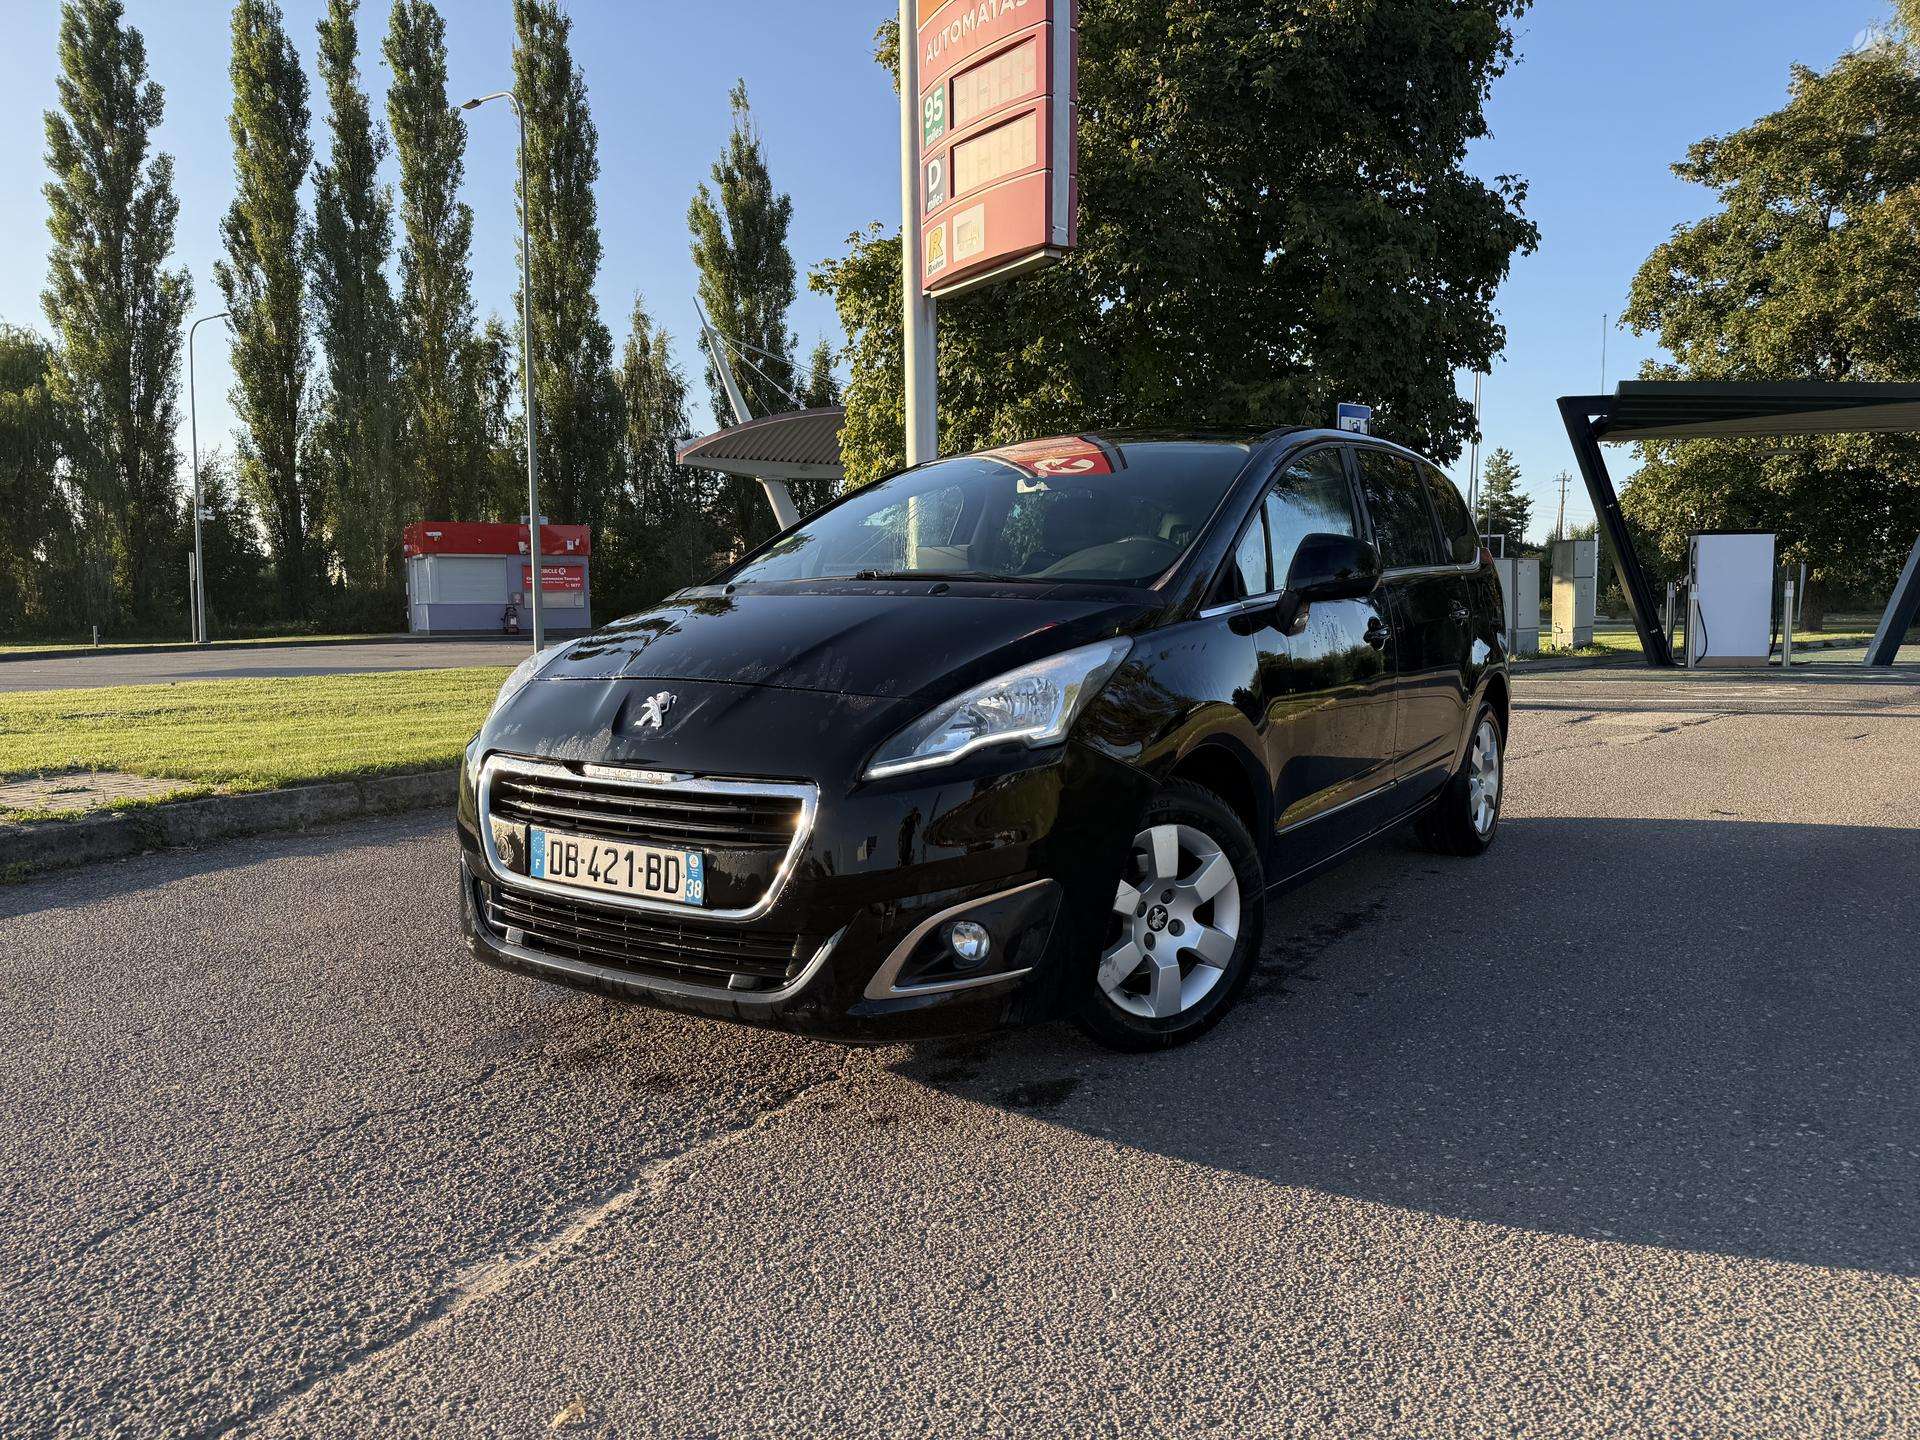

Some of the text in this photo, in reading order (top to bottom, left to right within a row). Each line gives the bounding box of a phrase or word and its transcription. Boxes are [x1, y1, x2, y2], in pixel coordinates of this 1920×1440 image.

[925, 87, 943, 129] 95
[926, 126, 943, 146] miles
[928, 158, 942, 194] D
[927, 192, 943, 212] miles
[535, 858, 541, 869] F
[549, 838, 680, 894] DB-421-BD
[686, 878, 702, 899] 38
